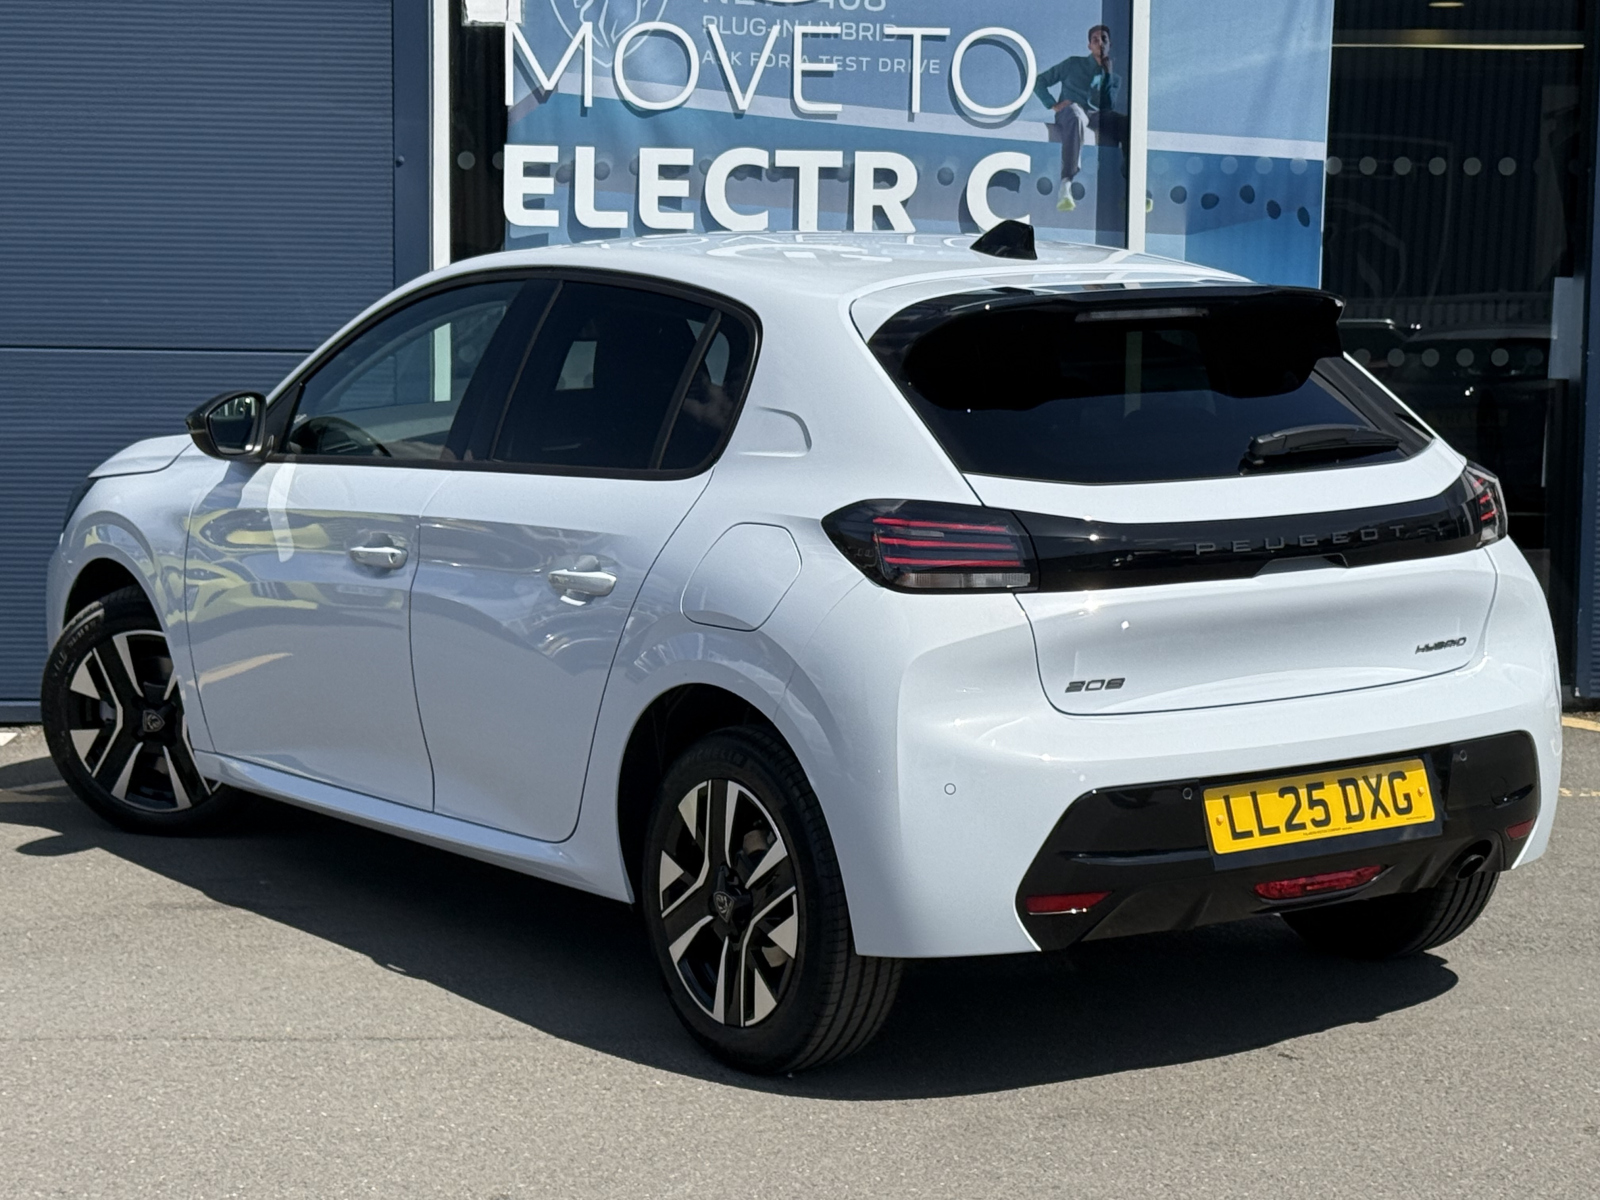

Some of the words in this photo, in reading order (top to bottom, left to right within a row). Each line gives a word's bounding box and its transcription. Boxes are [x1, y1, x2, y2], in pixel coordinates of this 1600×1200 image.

[504, 21, 843, 114] MOVE
[884, 26, 1037, 116] TO
[702, 50, 742, 66] AK
[1195, 525, 1405, 555] PEUGEOT
[1415, 637, 1466, 654] HYBRID
[1065, 678, 1125, 693] 208
[1223, 781, 1332, 841] LL25
[1338, 771, 1414, 824] DXG
